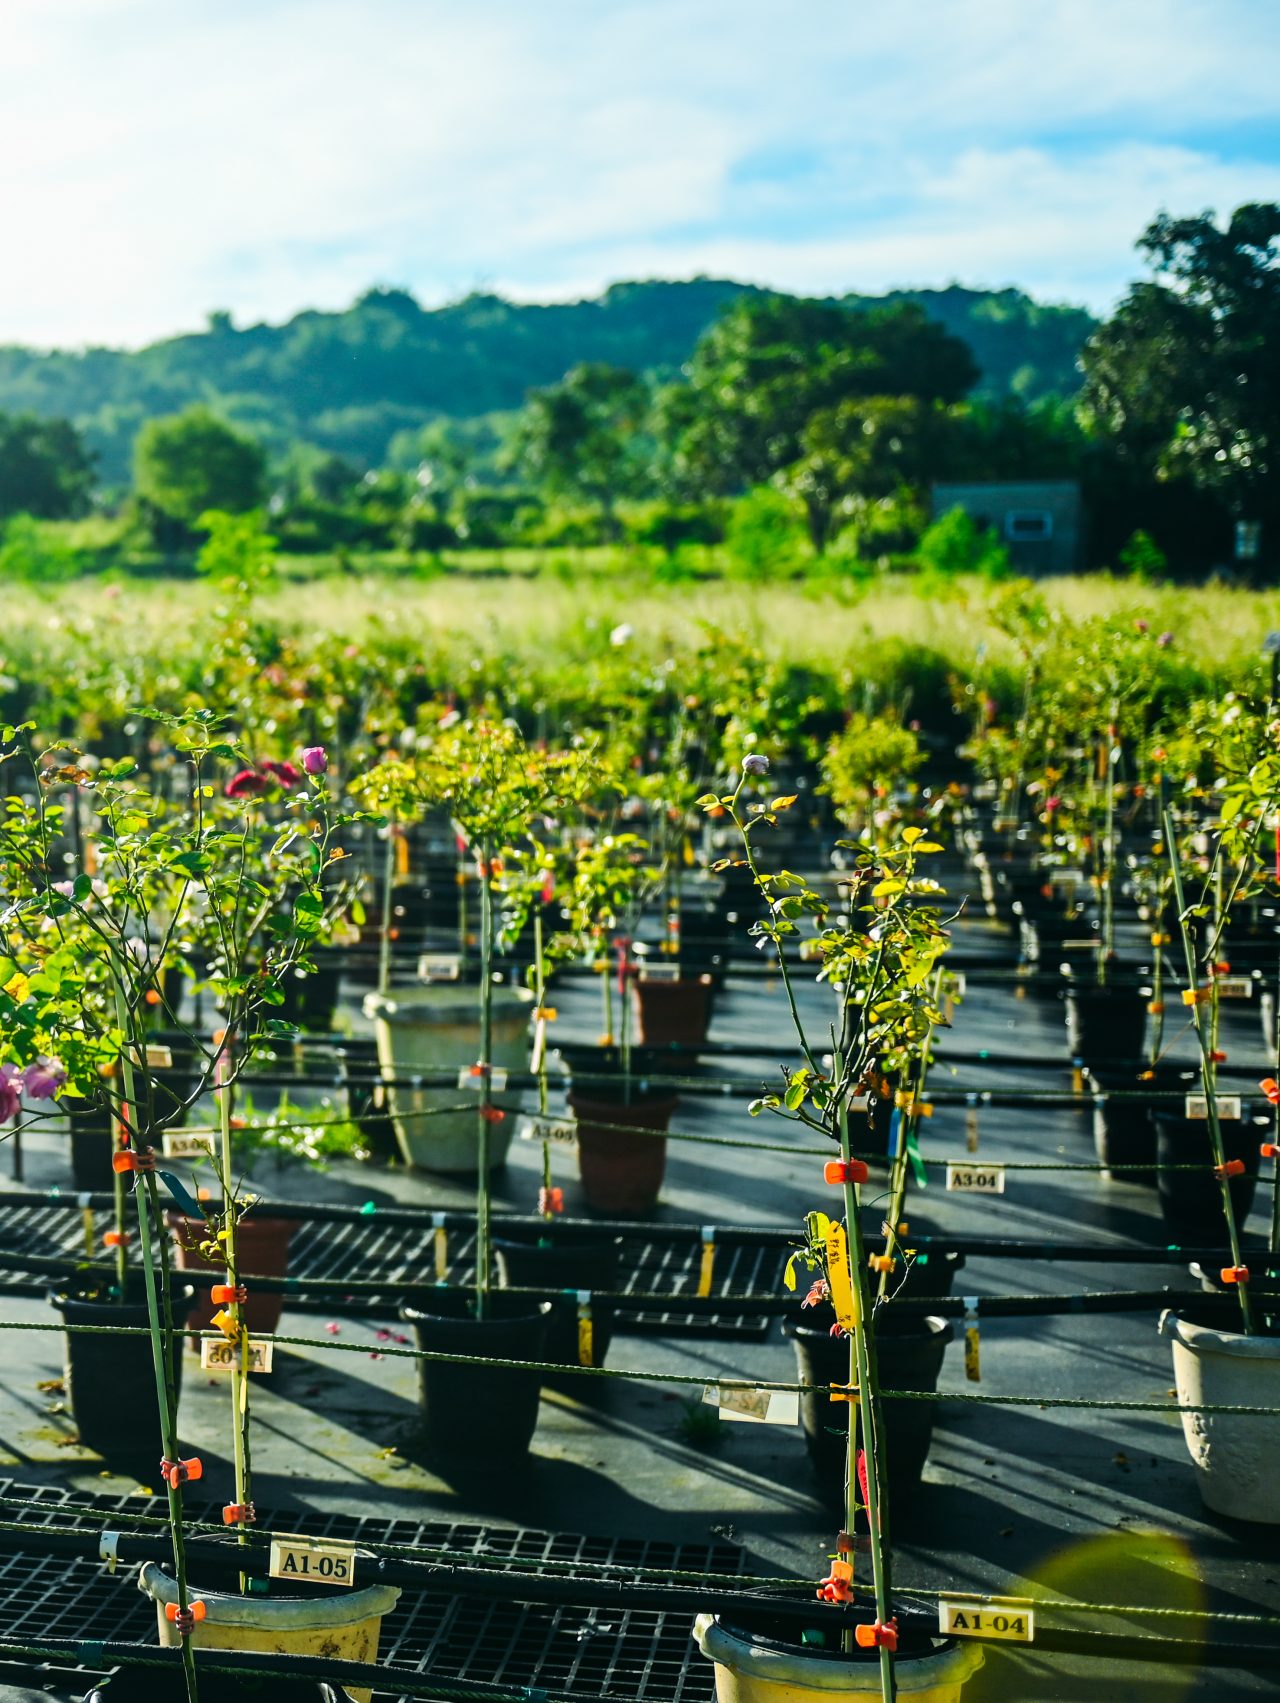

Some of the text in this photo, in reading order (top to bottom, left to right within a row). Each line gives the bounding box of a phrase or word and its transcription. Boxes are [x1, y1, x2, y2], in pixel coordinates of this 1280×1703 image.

[953, 1172, 996, 1187] A3-04
[282, 1553, 348, 1578] A1-05
[951, 1611, 1025, 1635] A1-04
